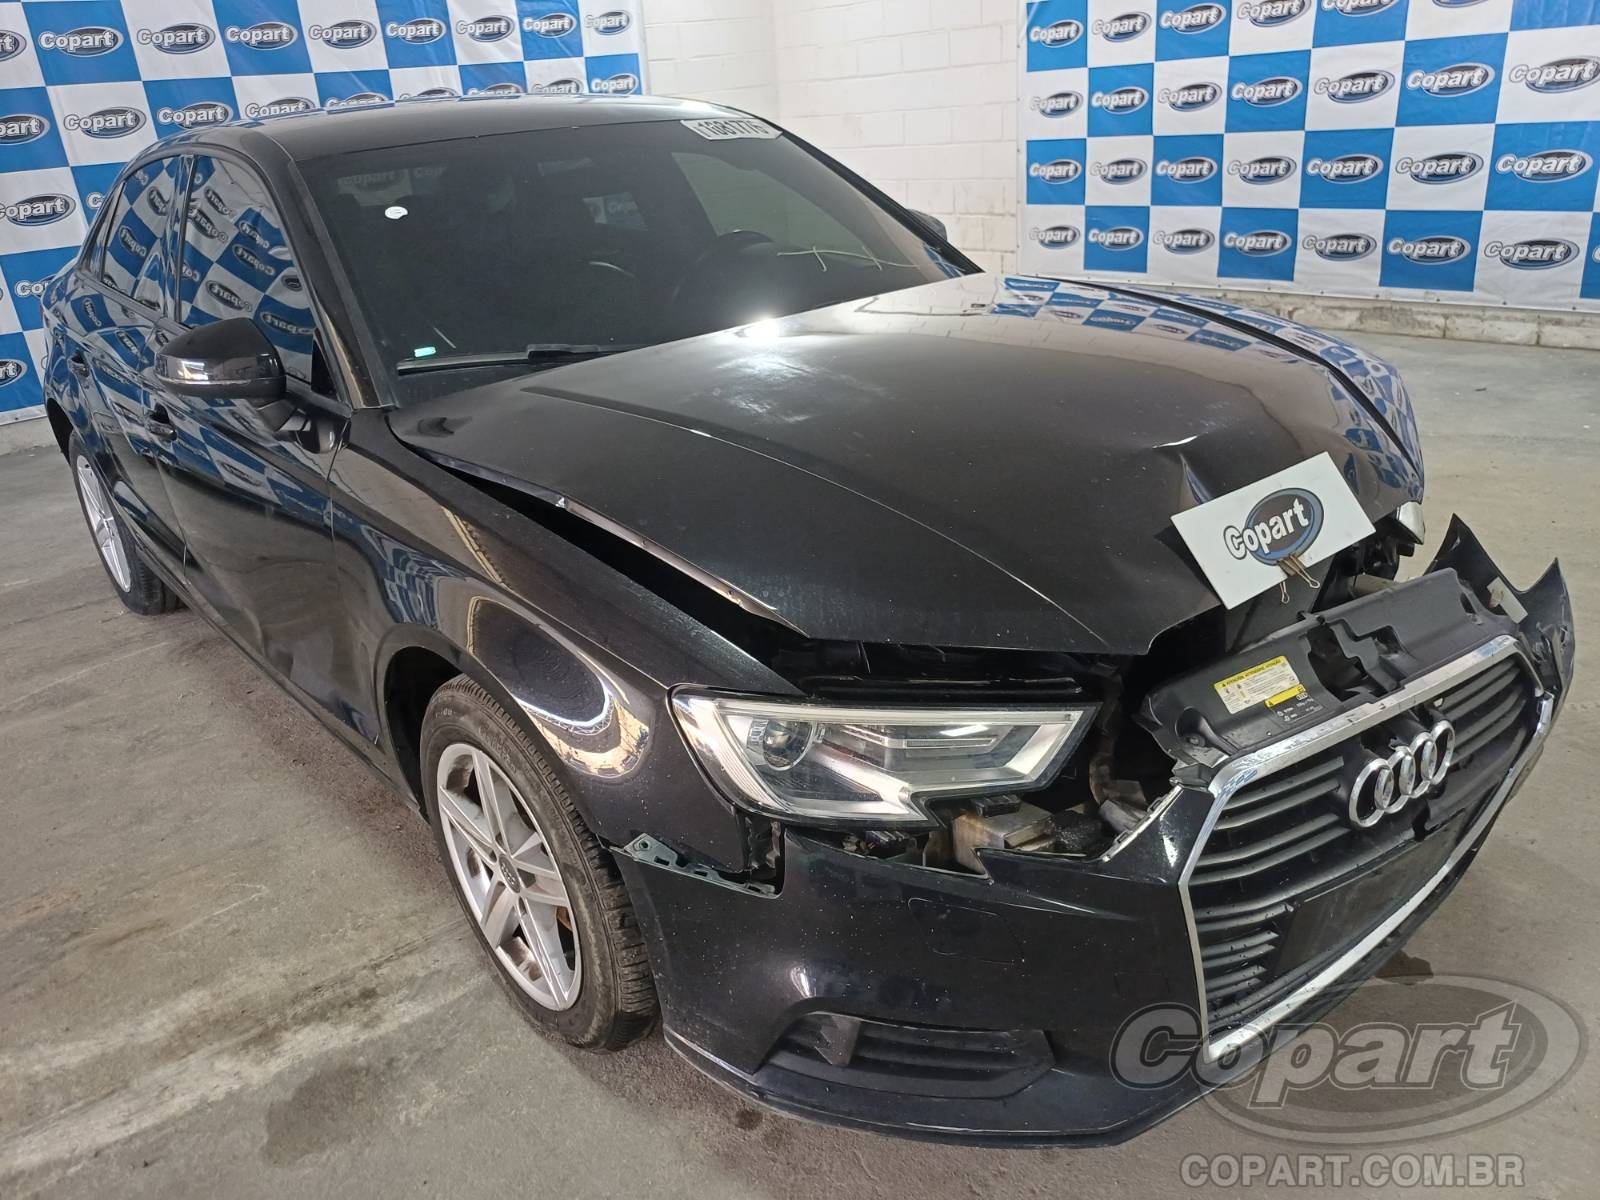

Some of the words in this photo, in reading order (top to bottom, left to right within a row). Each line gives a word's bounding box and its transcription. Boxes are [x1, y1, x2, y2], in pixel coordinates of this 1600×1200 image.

[386, 20, 440, 39] Copart
[457, 17, 509, 35] Copart
[523, 14, 571, 33] Copart
[585, 13, 627, 30] Copart
[1092, 16, 1143, 38] Copart
[1160, 7, 1219, 31] Copart
[40, 30, 114, 52] Copart
[137, 24, 206, 46] Copart
[225, 24, 290, 44] Copart
[309, 23, 369, 43] Copart
[1030, 24, 1076, 44] Copart
[592, 75, 633, 91] Copart
[1406, 67, 1486, 93] Copart
[1510, 60, 1598, 87] Copart
[1231, 79, 1293, 102] Copart
[1314, 73, 1384, 97] Copart
[1030, 93, 1076, 111] Copart
[1092, 90, 1141, 109] Copart
[1158, 85, 1214, 107] Copart
[64, 109, 137, 133] Copart
[158, 103, 226, 123] Copart
[1029, 161, 1075, 179] Copart
[1090, 160, 1140, 180] Copart
[1156, 159, 1209, 180] Copart
[1227, 158, 1288, 181] Copart
[1306, 157, 1375, 178] Copart
[1396, 155, 1472, 178] Copart
[1496, 154, 1581, 178] Copart
[1029, 227, 1075, 246] Copart
[1088, 228, 1137, 247] Copart
[1153, 230, 1207, 249] Copart
[1223, 232, 1284, 253] Copart
[1302, 235, 1368, 255] Copart
[1387, 237, 1460, 258] Copart
[1484, 241, 1565, 263] Copart
[1223, 498, 1310, 561] Copart
